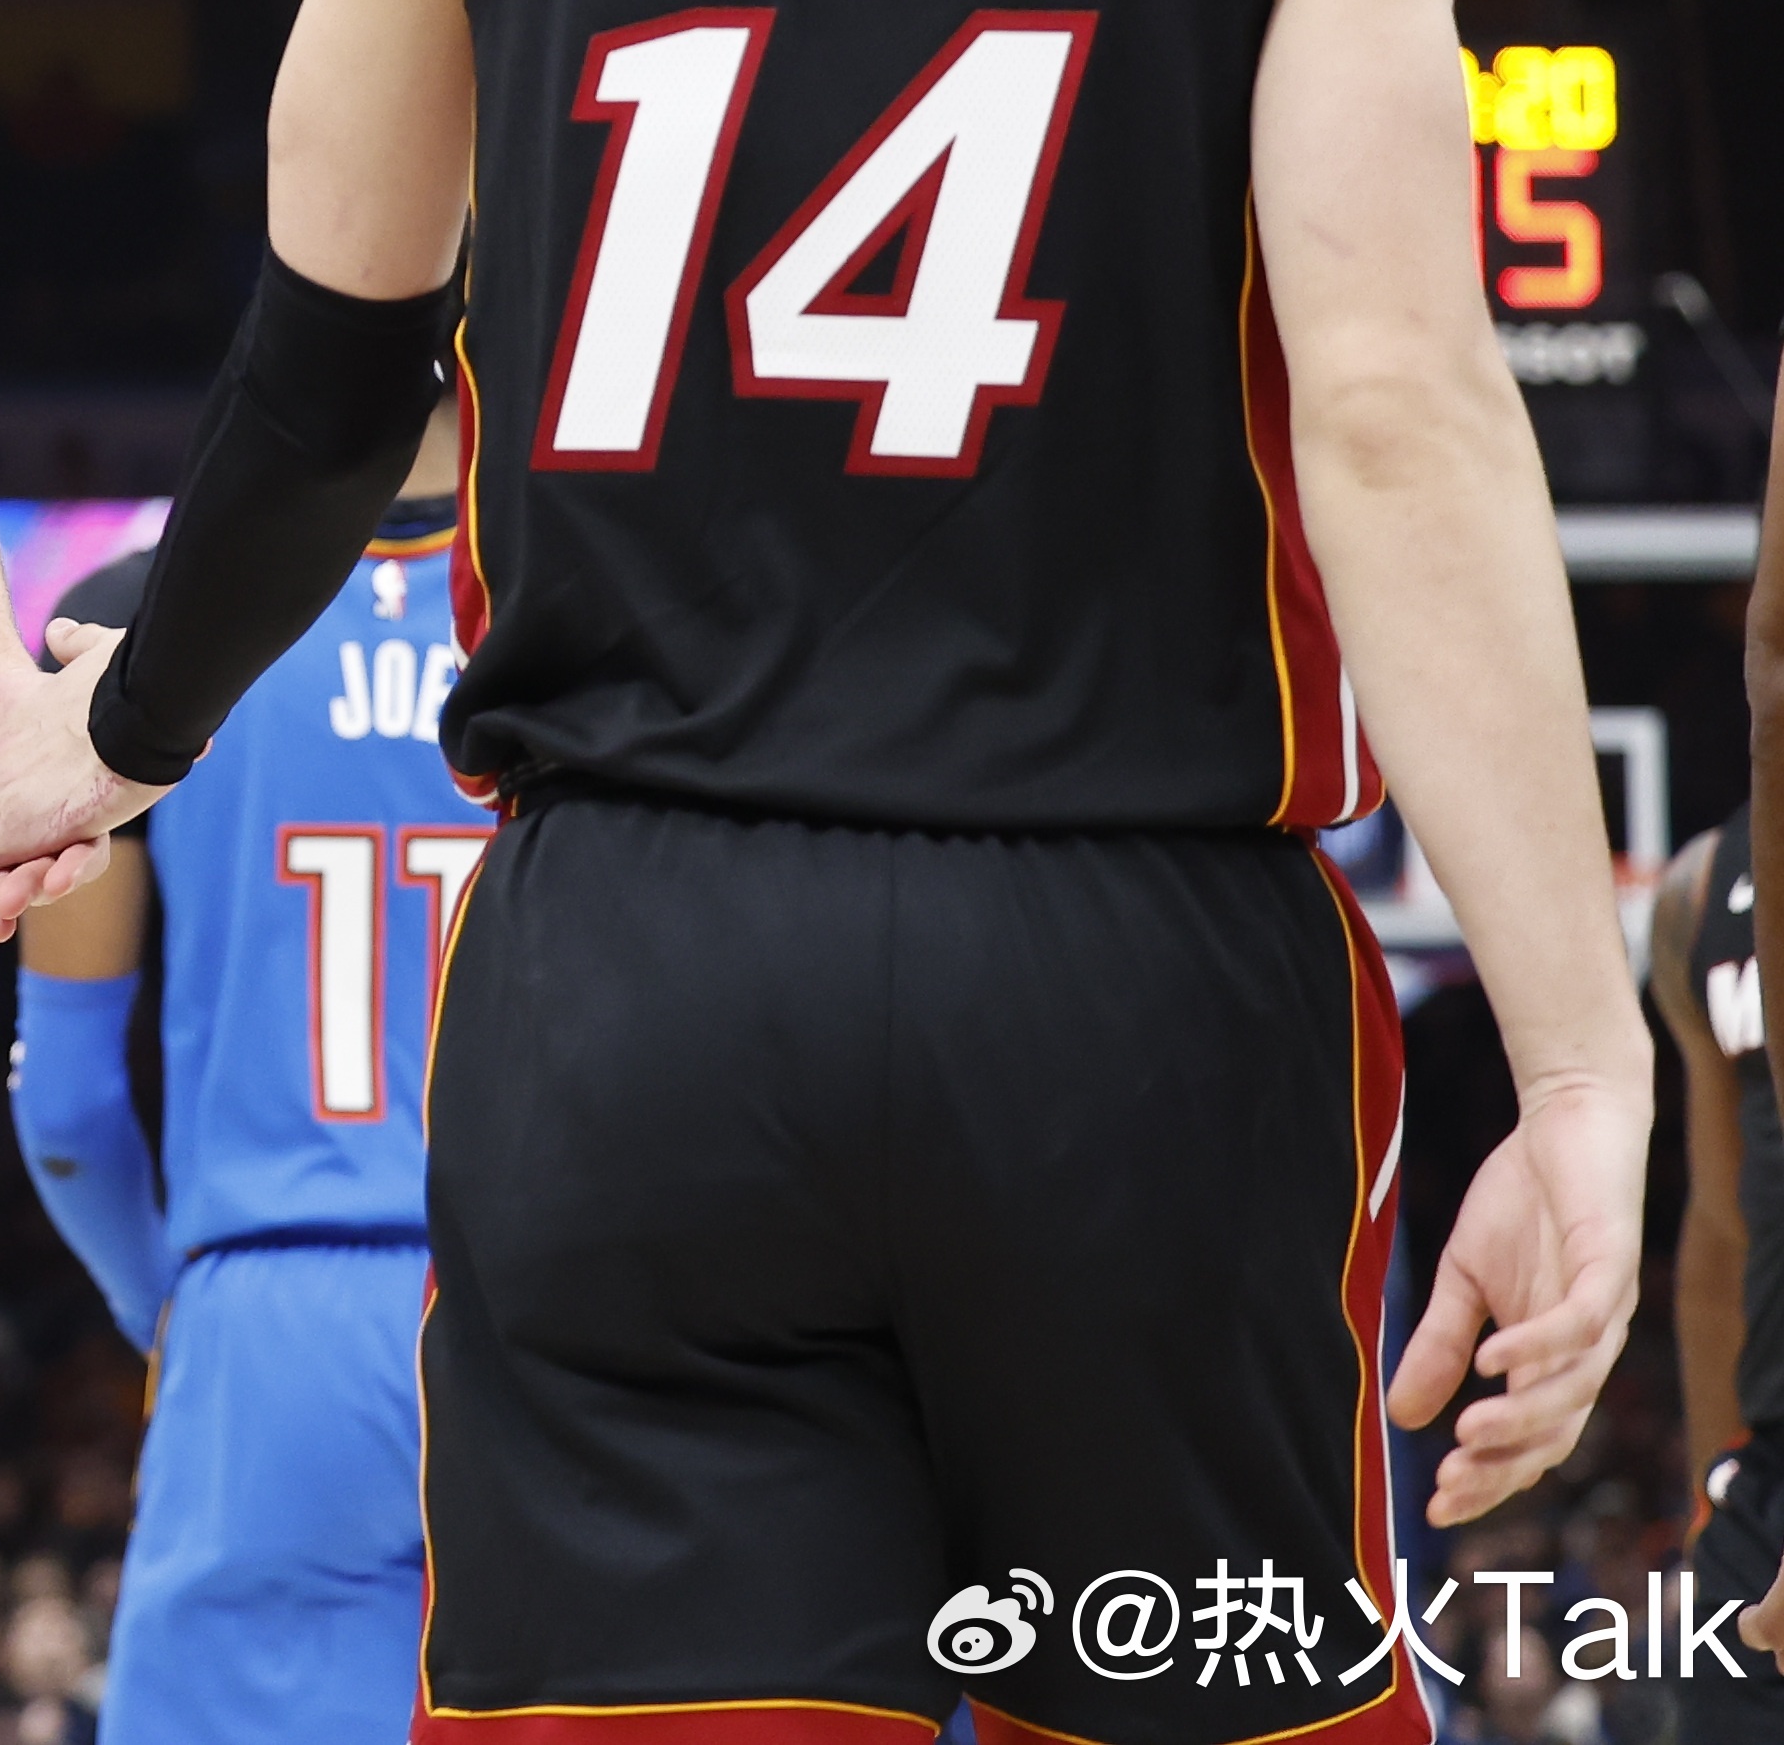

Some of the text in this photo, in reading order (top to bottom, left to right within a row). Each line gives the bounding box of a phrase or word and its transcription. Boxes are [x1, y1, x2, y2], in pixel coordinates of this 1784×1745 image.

[1459, 46, 1617, 151] :20
[530, 6, 1100, 477] 14
[1470, 147, 1603, 310] 5
[329, 639, 456, 742] JOE
